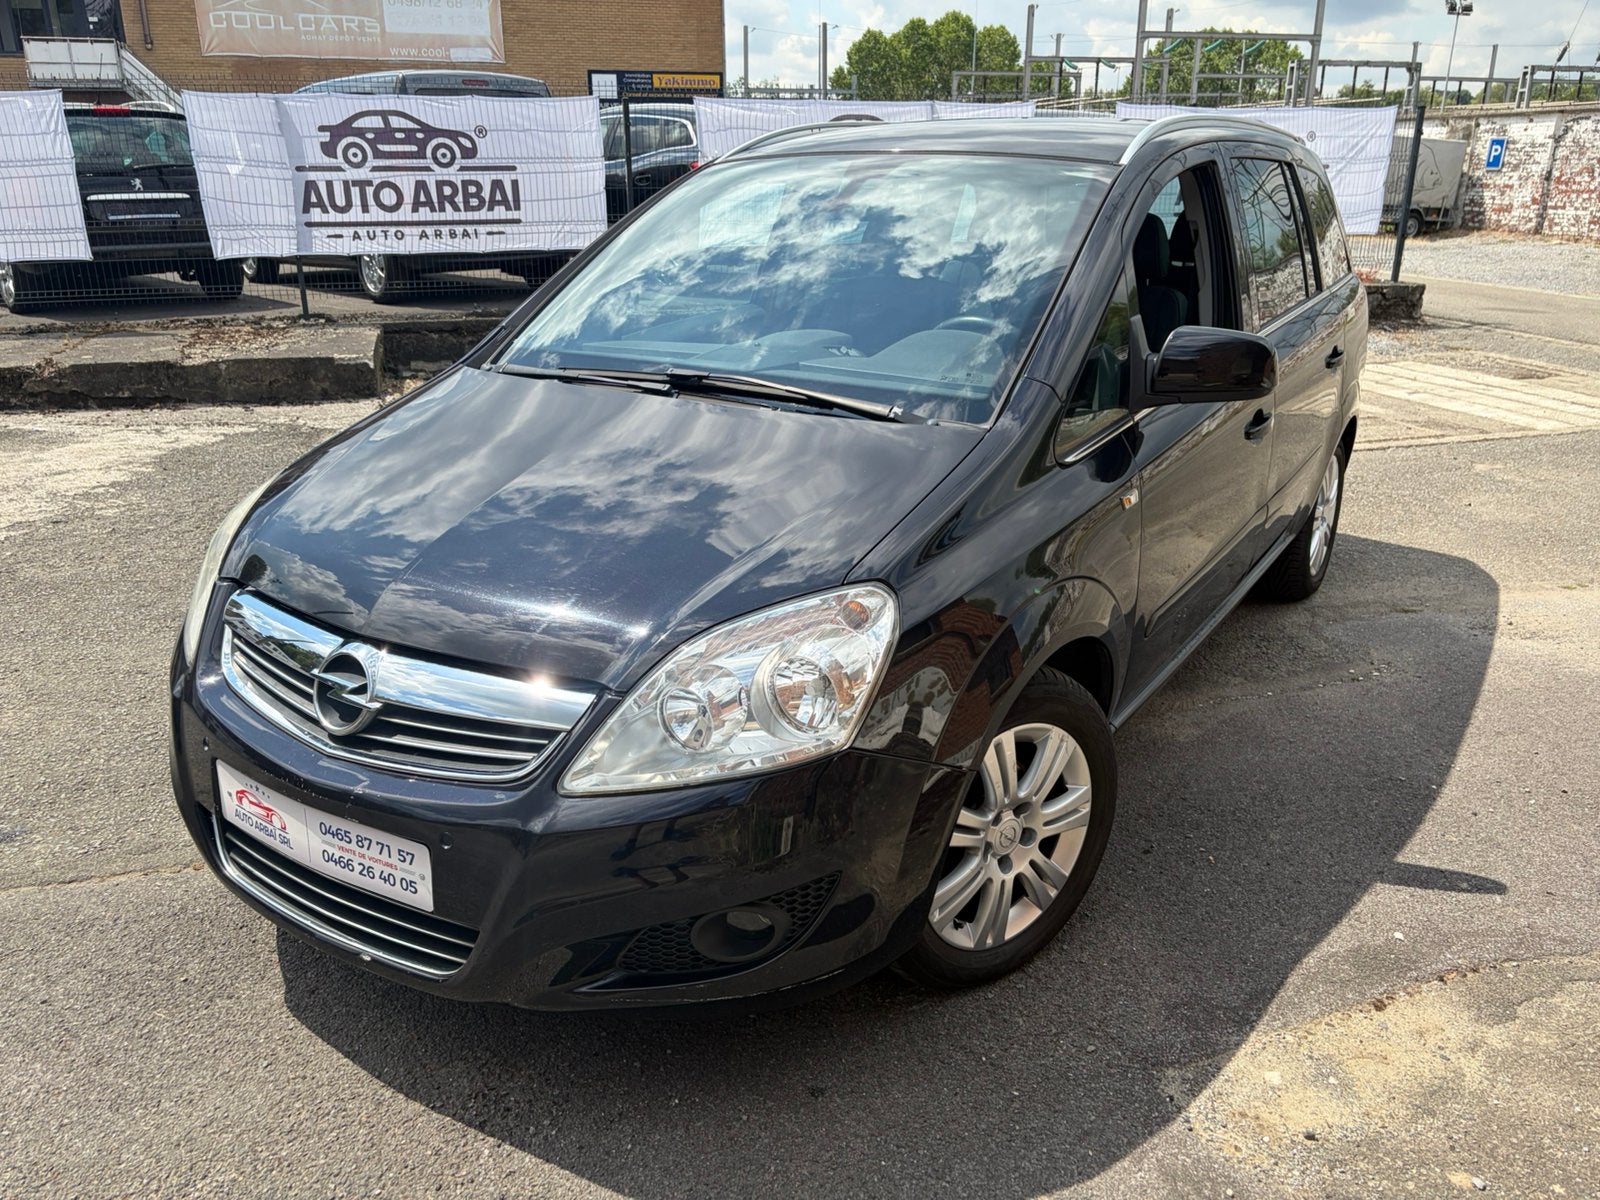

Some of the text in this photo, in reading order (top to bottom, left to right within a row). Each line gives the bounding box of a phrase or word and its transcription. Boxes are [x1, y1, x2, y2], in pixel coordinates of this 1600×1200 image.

[657, 76, 716, 86] Yakimmo
[1489, 145, 1501, 162] P
[302, 179, 521, 214] AUTO ARBAI
[352, 228, 479, 242] AUTO ARBAI
[234, 808, 254, 827] AUTO
[278, 833, 294, 850] SRL
[319, 821, 415, 866] 0465 87 71 57
[322, 849, 418, 895] 0466 26 40 05
[336, 844, 399, 871] VENTE DE VOITURES
